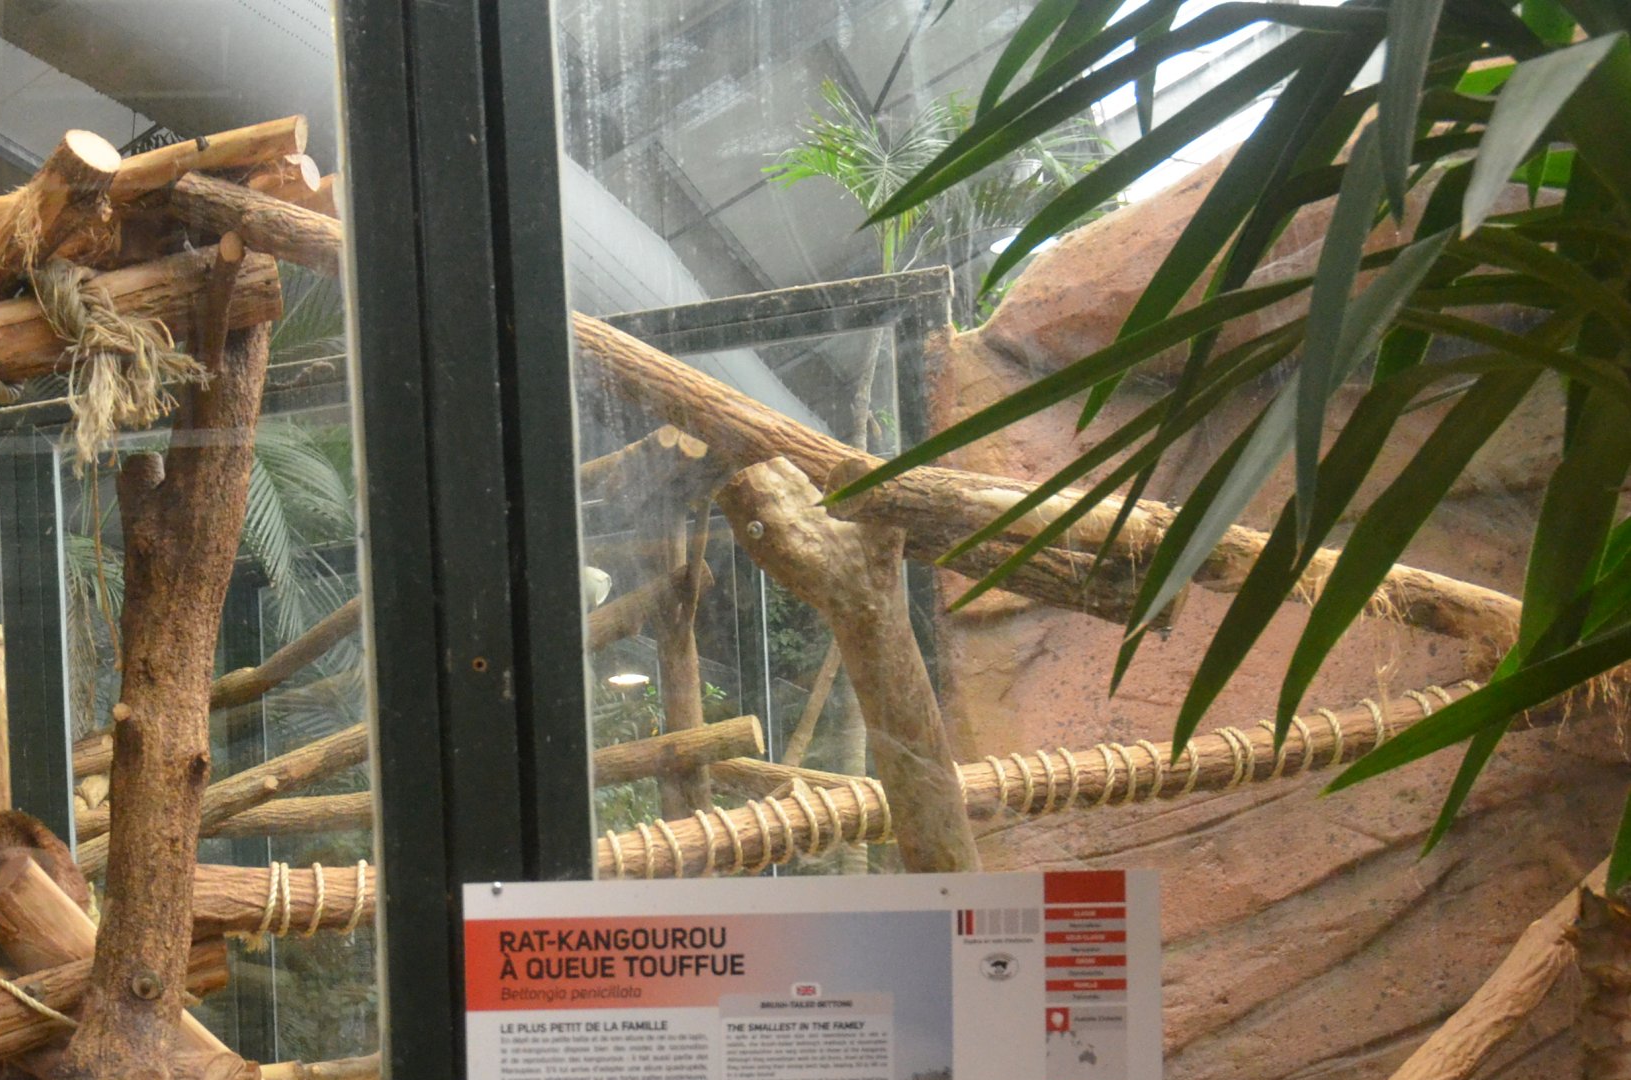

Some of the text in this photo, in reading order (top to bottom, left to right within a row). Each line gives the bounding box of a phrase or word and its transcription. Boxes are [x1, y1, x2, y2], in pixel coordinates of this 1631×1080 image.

[499, 927, 727, 952] RAT-KANGOUROU
[499, 952, 745, 980] À QUEUE TOUFFUE
[501, 984, 642, 1003] Bettongia penicillata
[501, 1020, 668, 1034] LE PLUS PETIT DE LA FAMILLE
[727, 1021, 865, 1032] THE SMALLEST IN THE FAMILY
